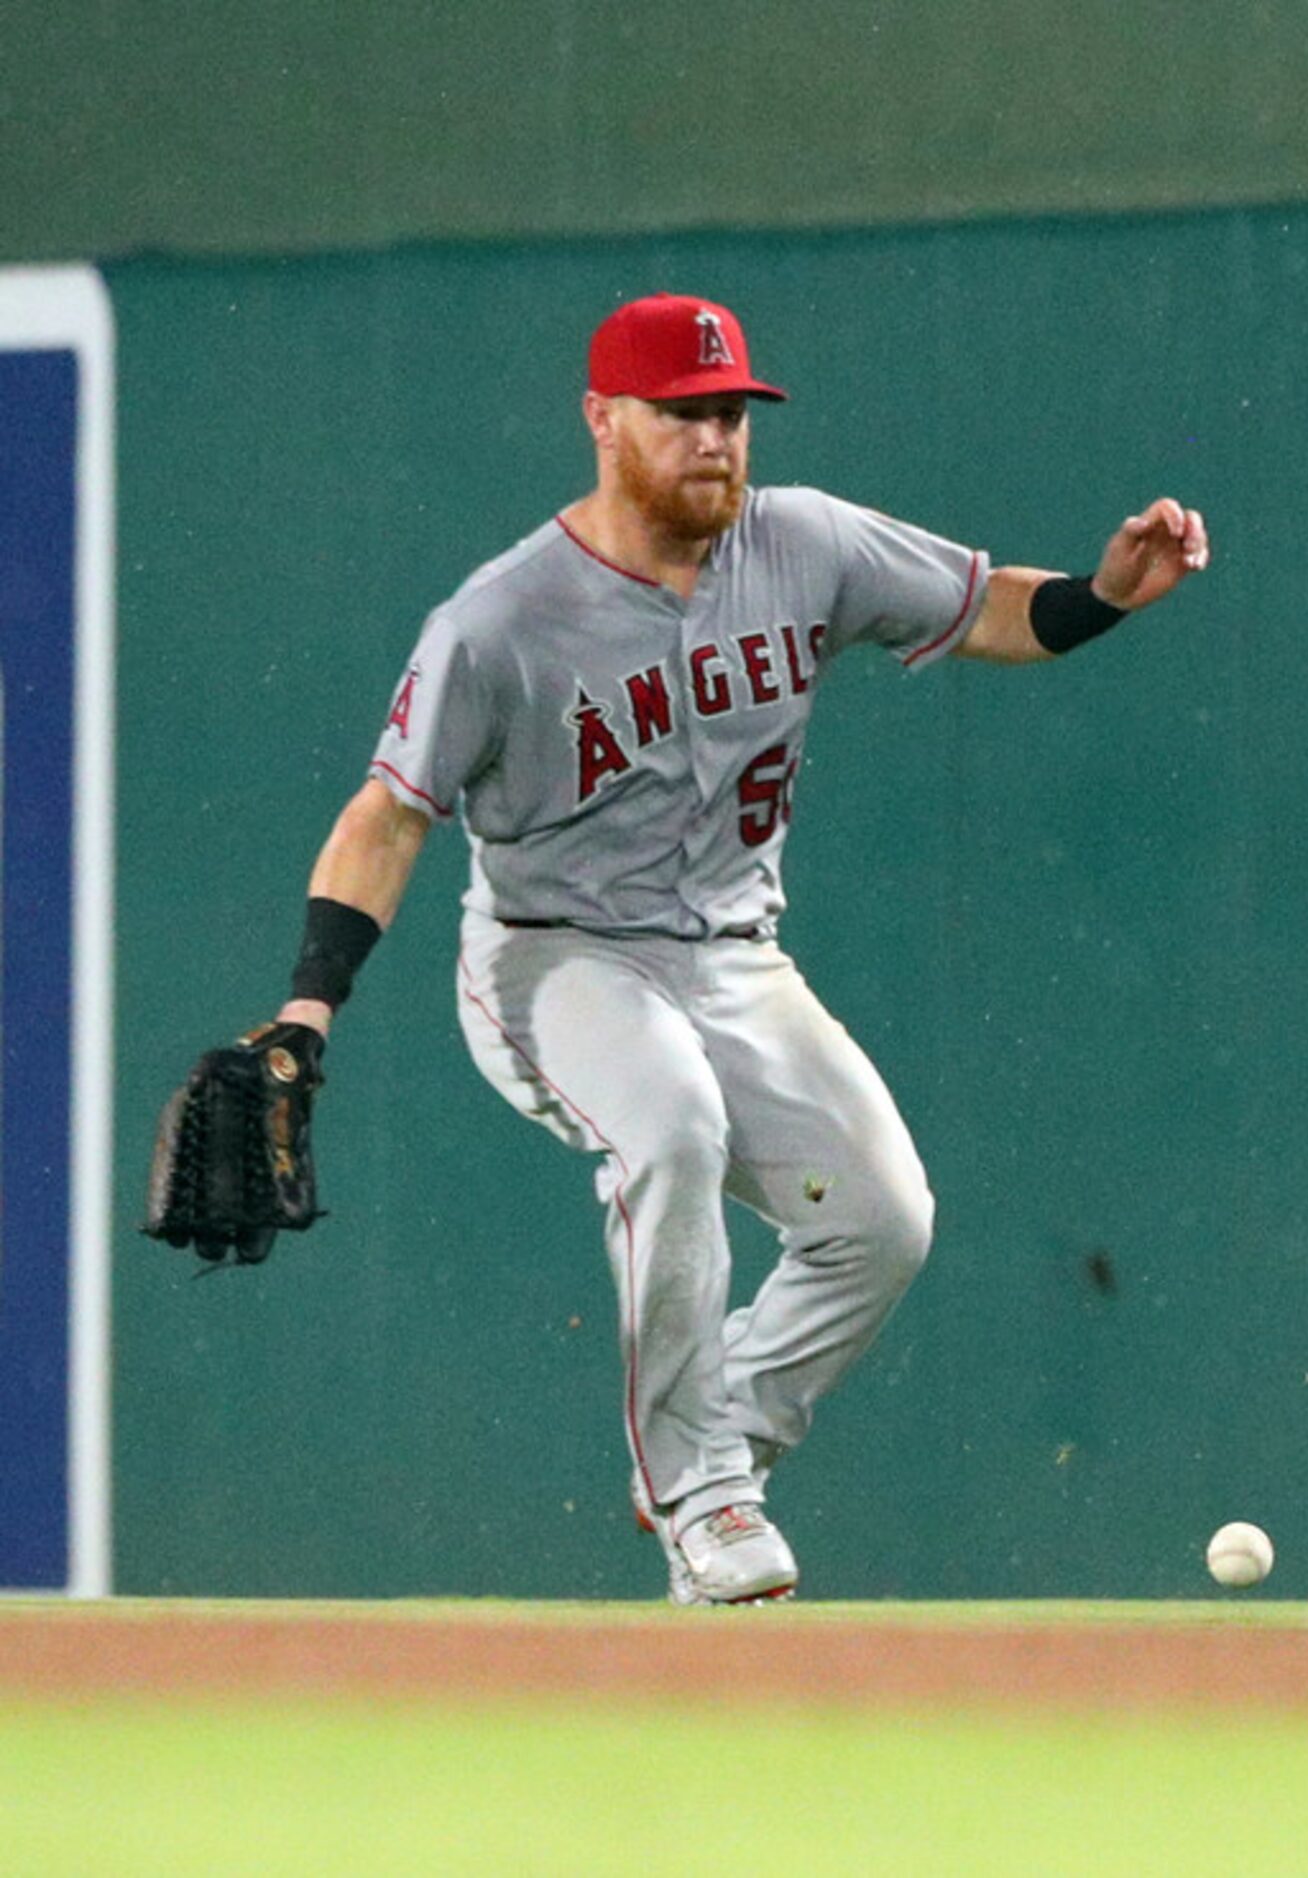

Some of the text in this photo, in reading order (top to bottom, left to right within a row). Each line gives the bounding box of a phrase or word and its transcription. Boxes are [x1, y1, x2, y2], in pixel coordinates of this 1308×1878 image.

[697, 311, 735, 365] A
[384, 664, 418, 739] A
[738, 743, 798, 848] 5
